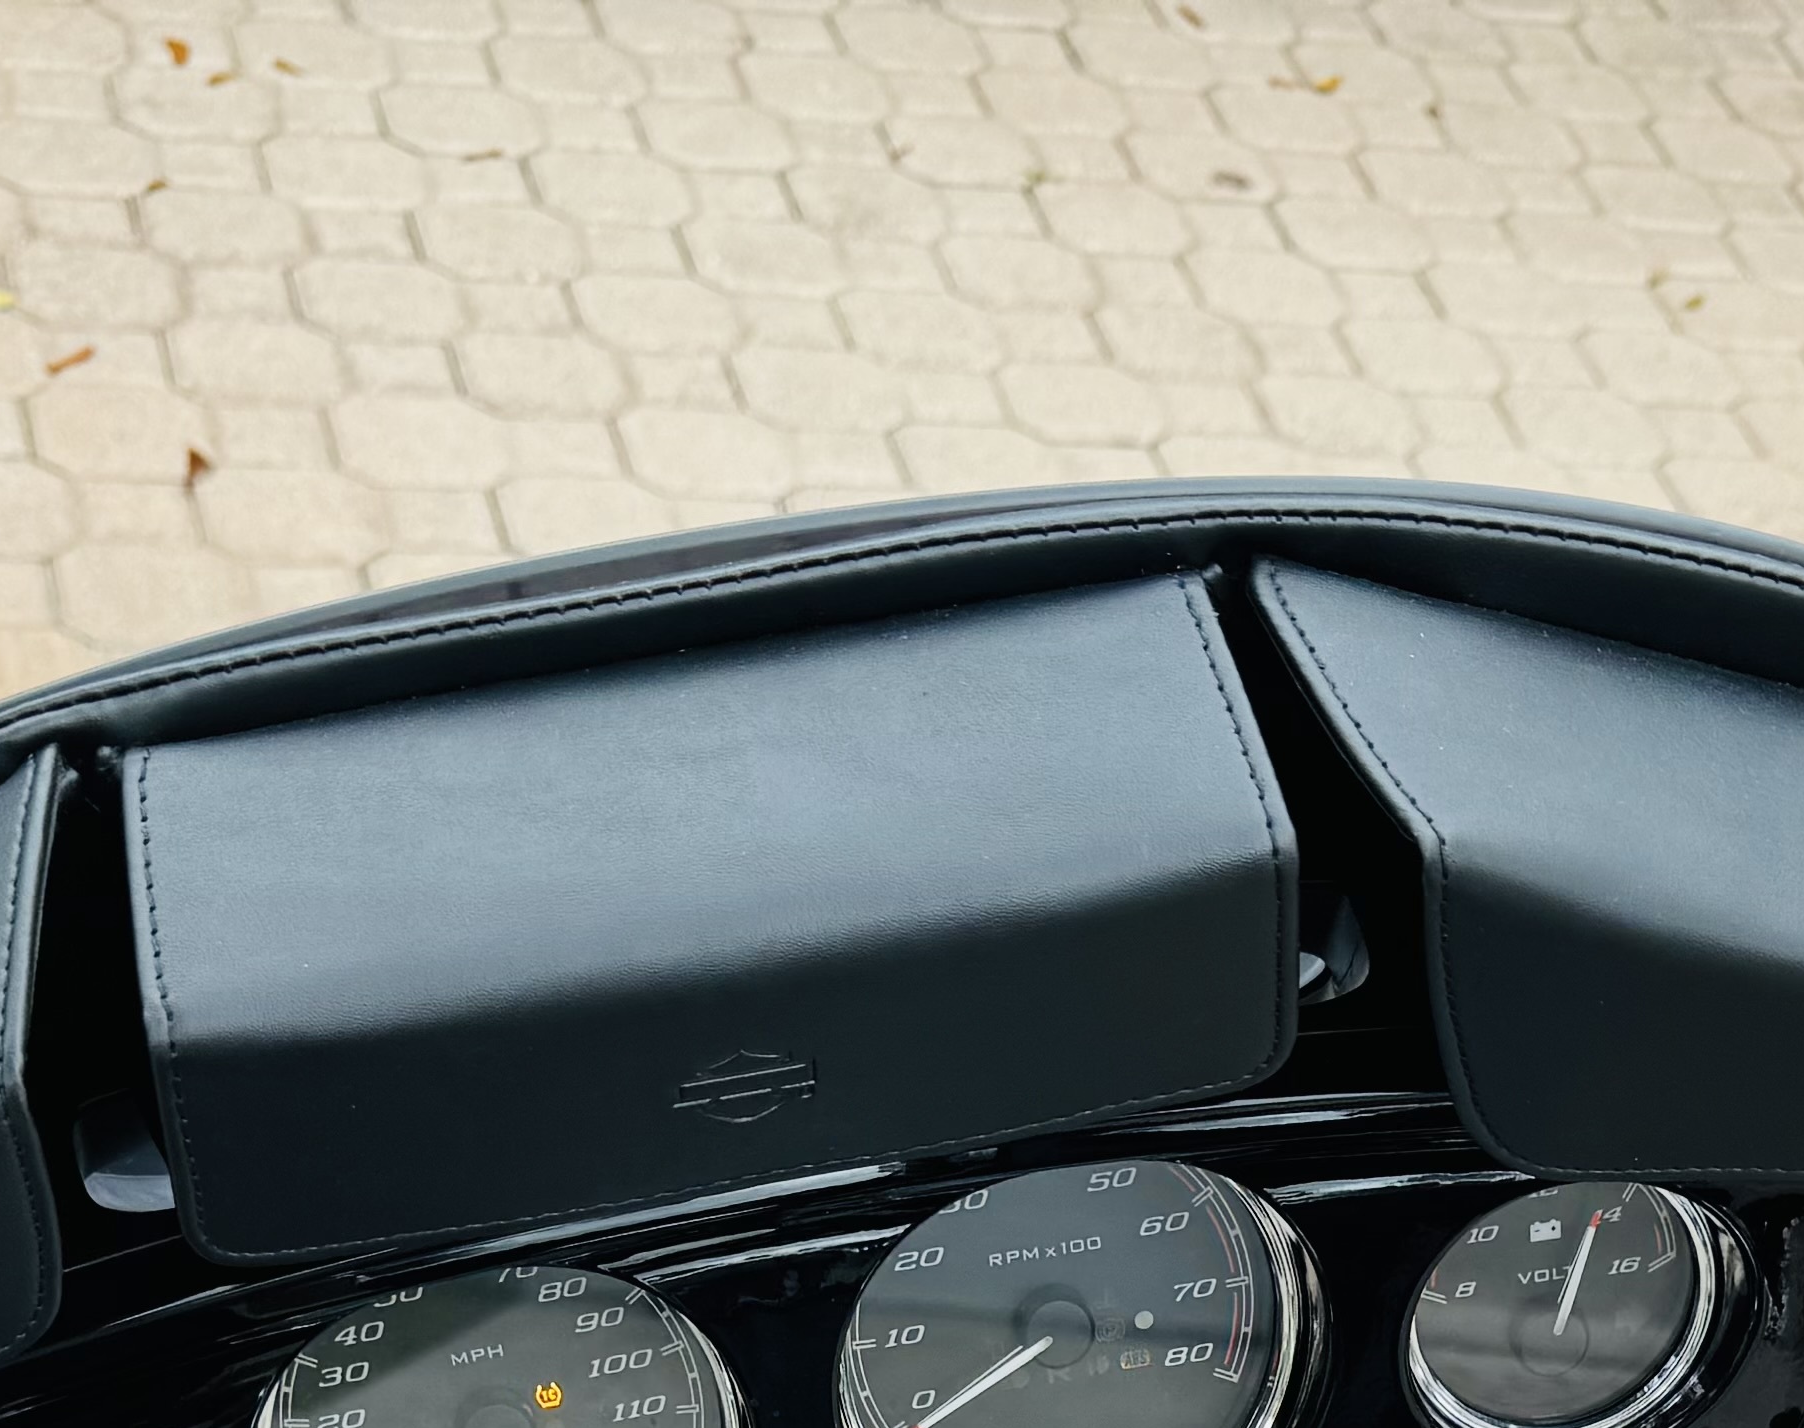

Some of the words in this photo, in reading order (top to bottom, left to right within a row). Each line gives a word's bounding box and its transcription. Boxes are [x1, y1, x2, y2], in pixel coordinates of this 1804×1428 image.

[1086, 1167, 1138, 1193] 50
[1139, 1211, 1190, 1237] 60
[1466, 1225, 1499, 1244] 10
[894, 1246, 945, 1272] 20
[1607, 1257, 1641, 1275] 16
[537, 1276, 588, 1303] 80
[1173, 1278, 1217, 1302] 70
[1454, 1281, 1477, 1299] 8
[574, 1306, 625, 1333] 90
[334, 1320, 385, 1346] 40
[883, 1324, 926, 1349] 10
[450, 1344, 504, 1367] MPH
[588, 1348, 654, 1379] 100
[1164, 1342, 1214, 1368] 80
[318, 1361, 370, 1388] 30
[611, 1395, 667, 1423] 110
[911, 1389, 937, 1410] 0
